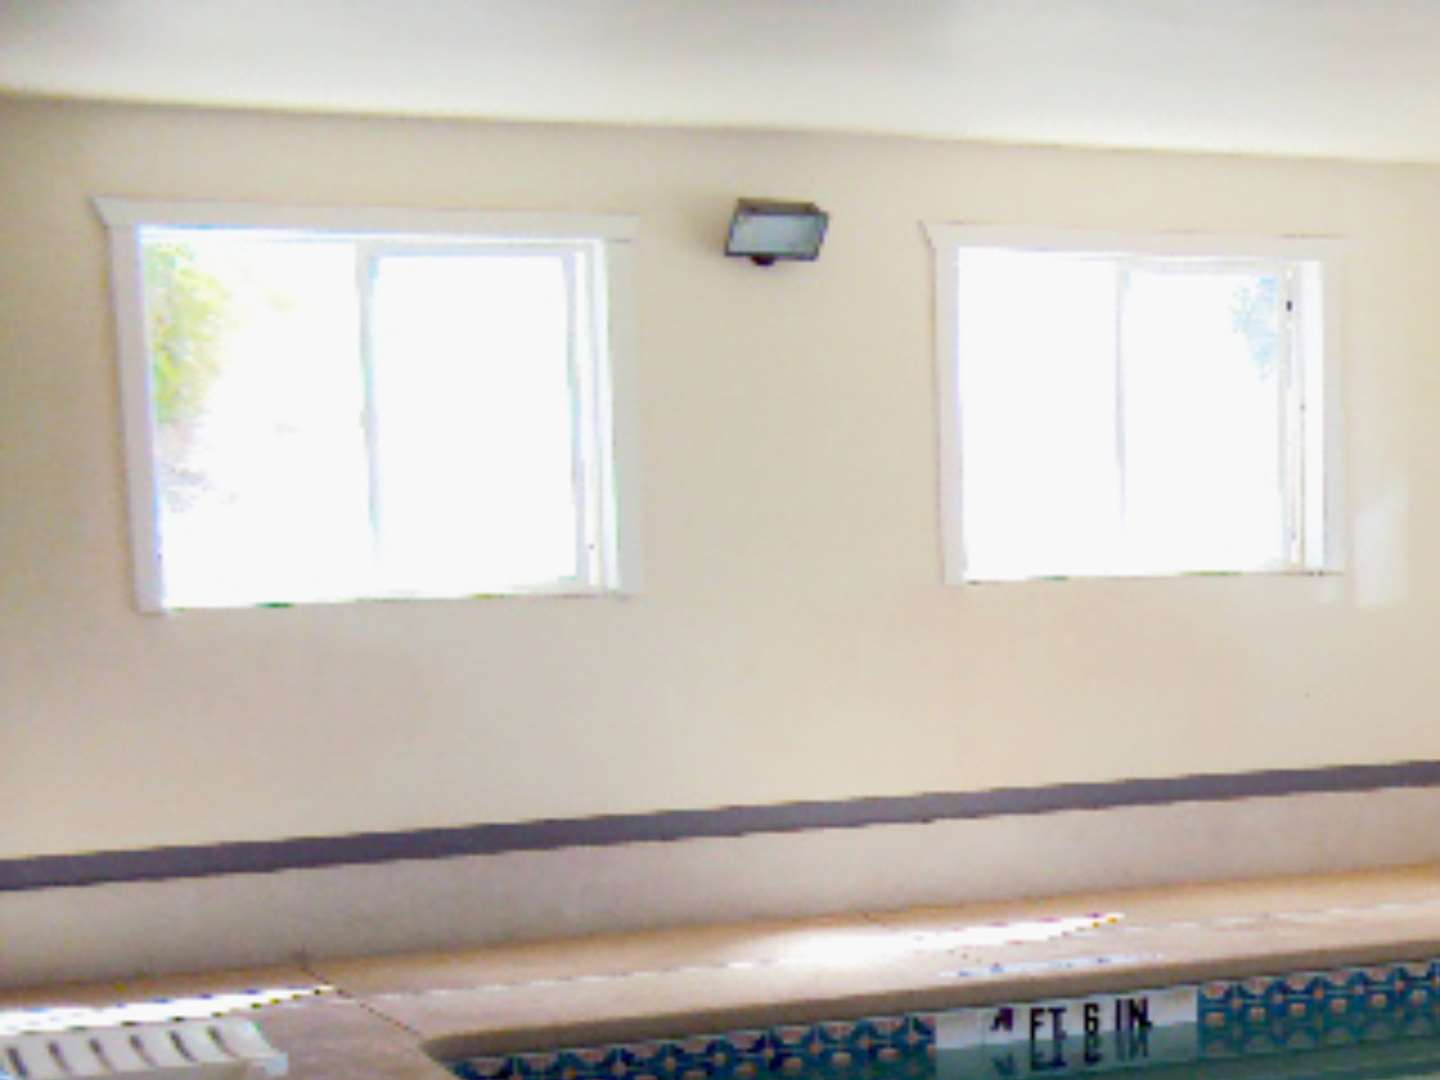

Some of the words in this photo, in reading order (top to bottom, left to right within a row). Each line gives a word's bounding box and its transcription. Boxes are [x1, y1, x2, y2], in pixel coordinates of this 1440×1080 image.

[1029, 1006, 1067, 1041] FT
[1083, 1002, 1100, 1035] 6
[1114, 996, 1153, 1031] IN
